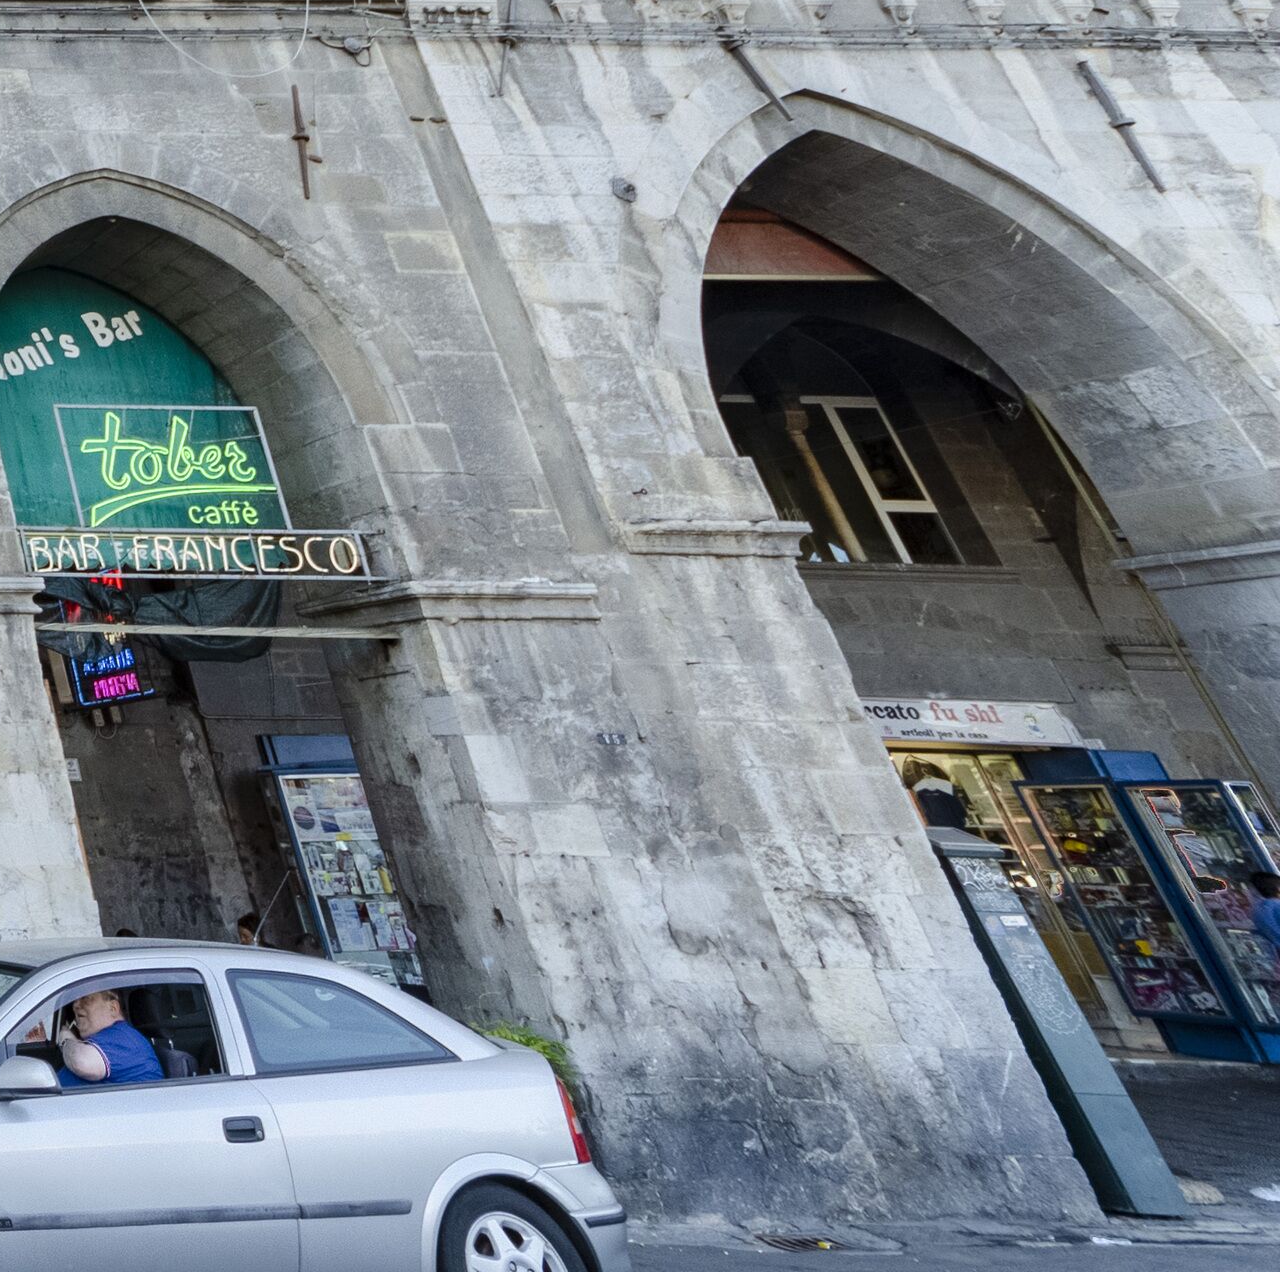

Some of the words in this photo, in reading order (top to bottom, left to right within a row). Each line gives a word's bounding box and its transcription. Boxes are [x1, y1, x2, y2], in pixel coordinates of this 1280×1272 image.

[80, 310, 143, 348] Bar
[80, 411, 257, 490] tober
[188, 501, 259, 526] caffè
[29, 533, 106, 573] BAR
[133, 535, 359, 574] FRANCESCO
[929, 701, 960, 722] fu
[965, 703, 1003, 724] shi
[900, 728, 935, 738] articoli
[938, 730, 954, 741] per
[954, 729, 965, 739] la
[967, 731, 990, 740] casa
